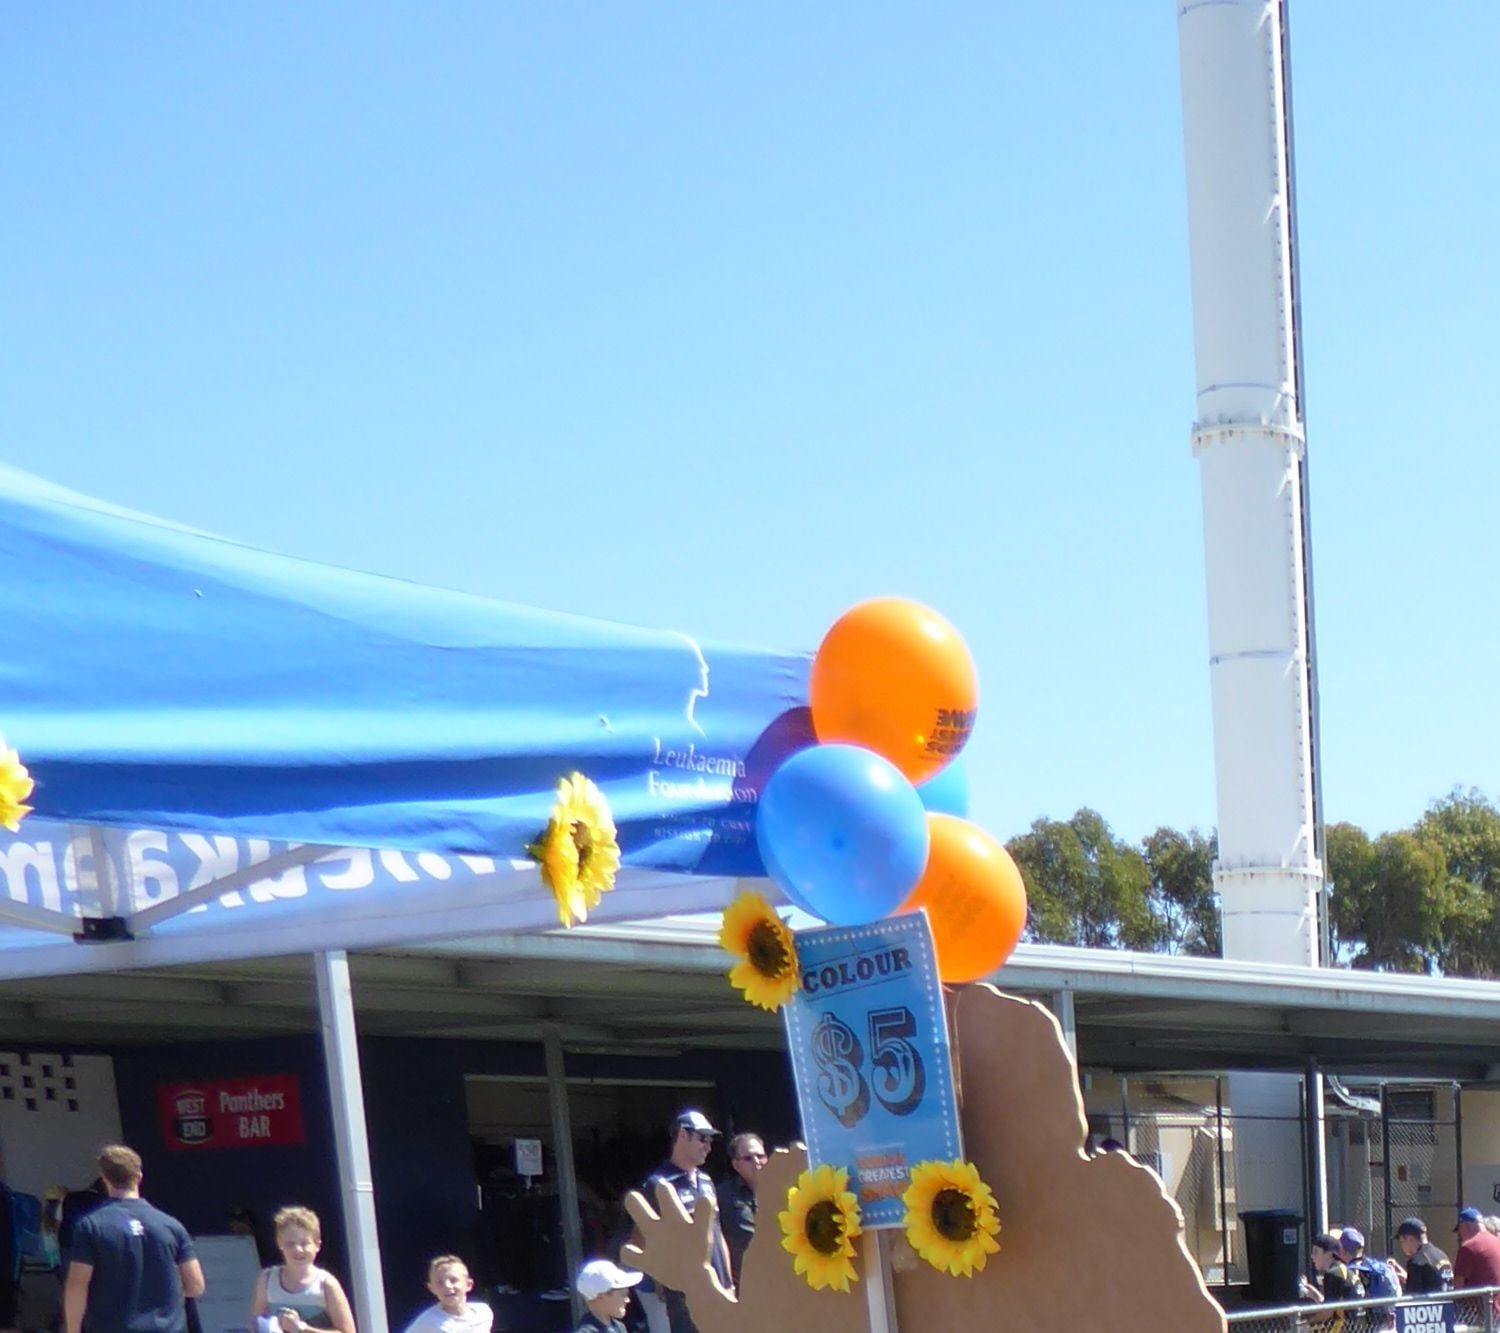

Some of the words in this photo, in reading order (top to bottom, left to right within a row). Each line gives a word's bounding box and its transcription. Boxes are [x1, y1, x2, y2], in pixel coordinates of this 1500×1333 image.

[653, 737, 746, 778] Leukaemia
[802, 947, 912, 994] COLOUR
[811, 1006, 926, 1129] $5
[218, 1088, 285, 1113] Panthers
[239, 1115, 271, 1138] BAR
[1403, 1304, 1443, 1324] NOW
